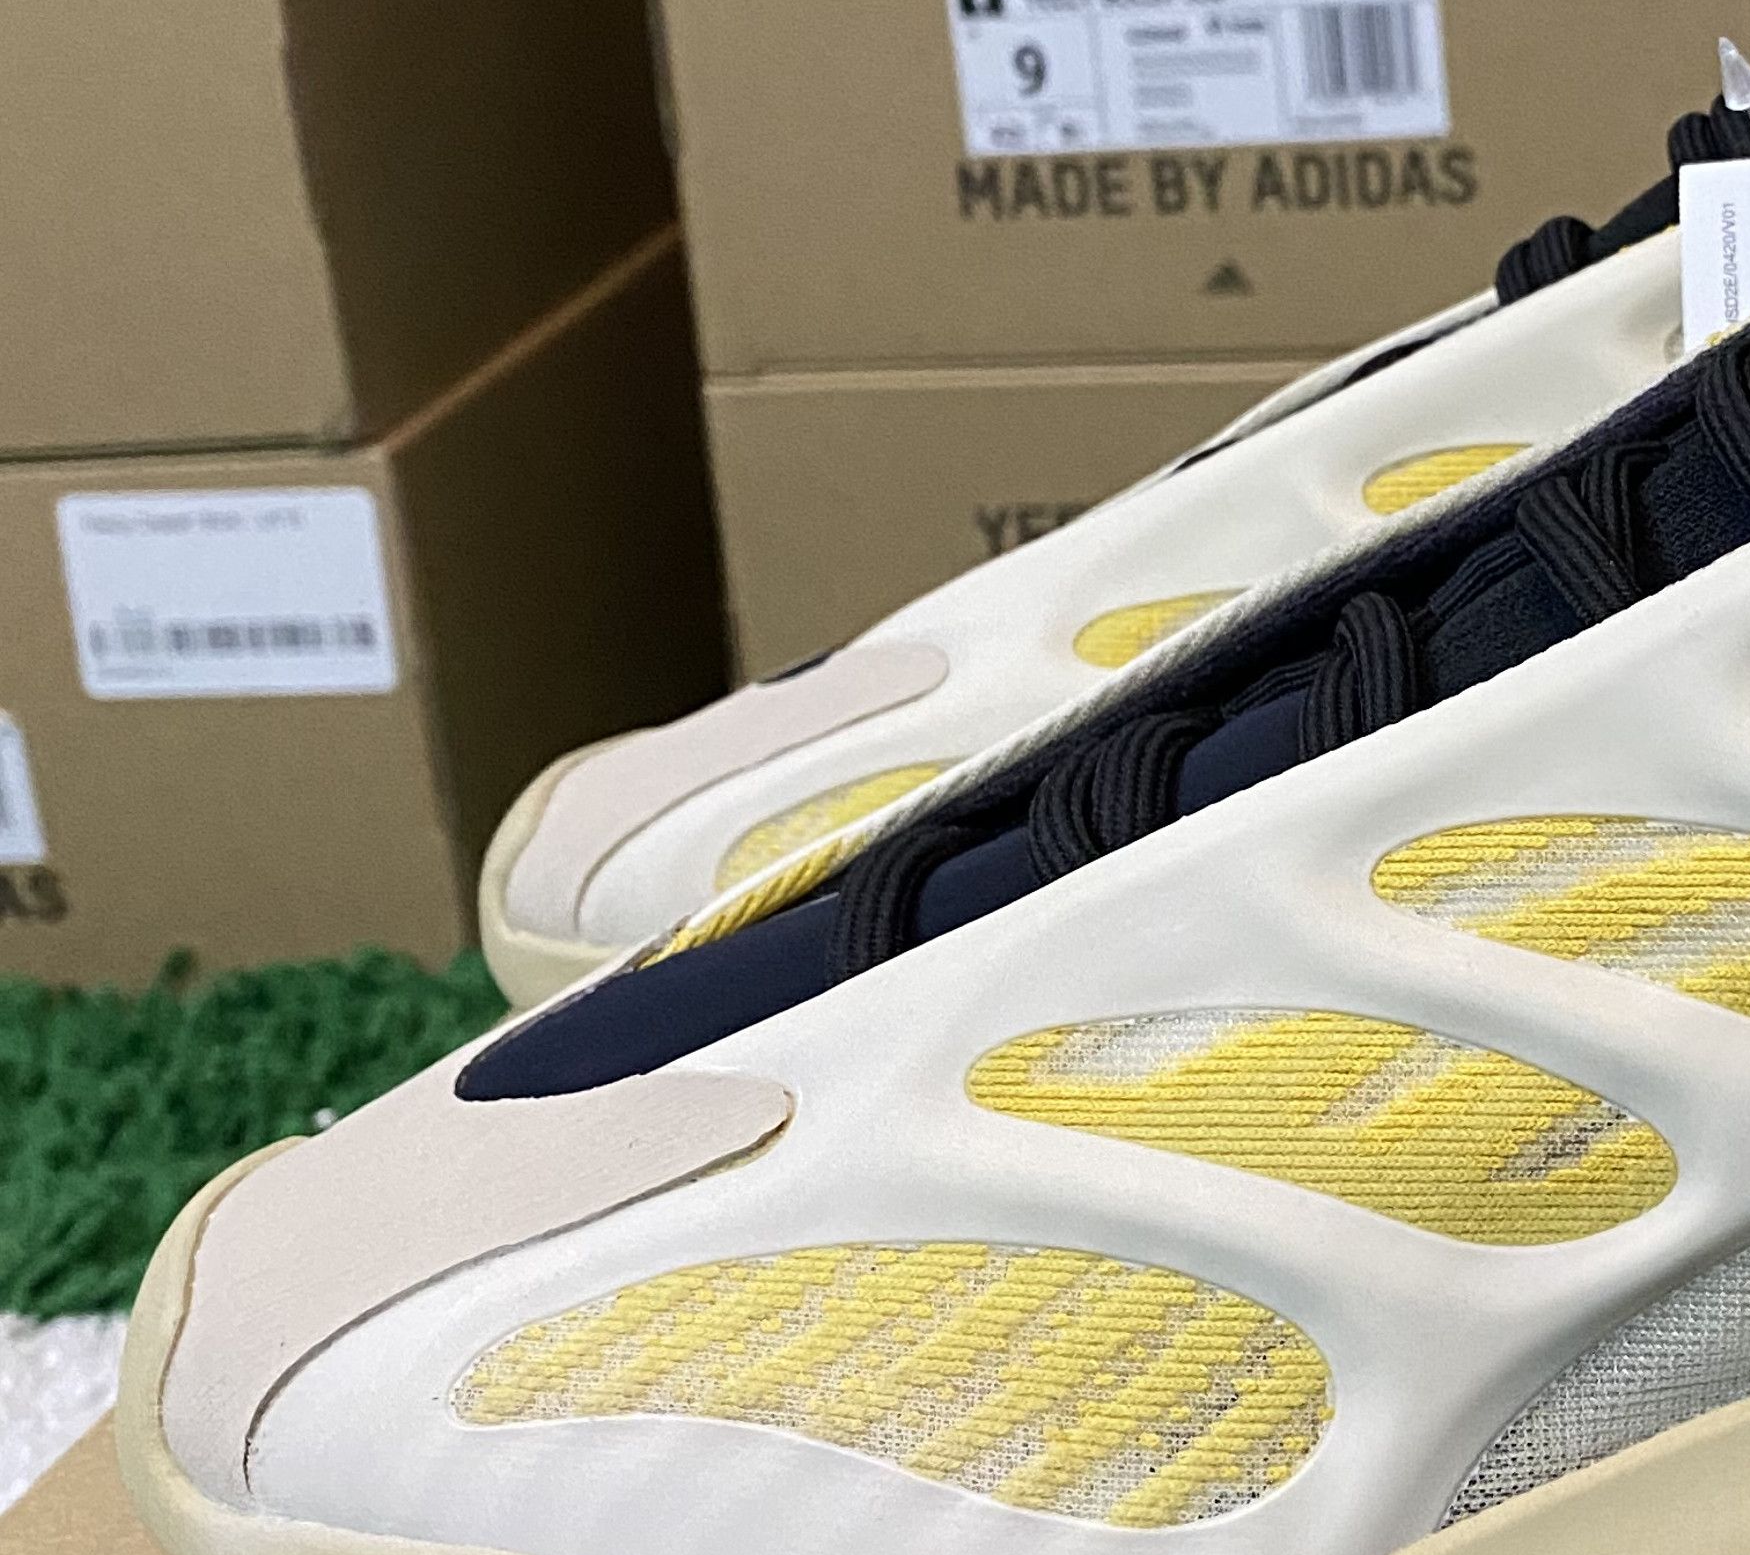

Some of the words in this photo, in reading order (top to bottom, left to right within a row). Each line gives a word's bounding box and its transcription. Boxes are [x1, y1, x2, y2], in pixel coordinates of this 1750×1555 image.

[1010, 41, 1049, 99] 9
[954, 153, 1135, 223] MADE
[1147, 151, 1230, 218] BY
[1249, 144, 1481, 213] ADIDAS
